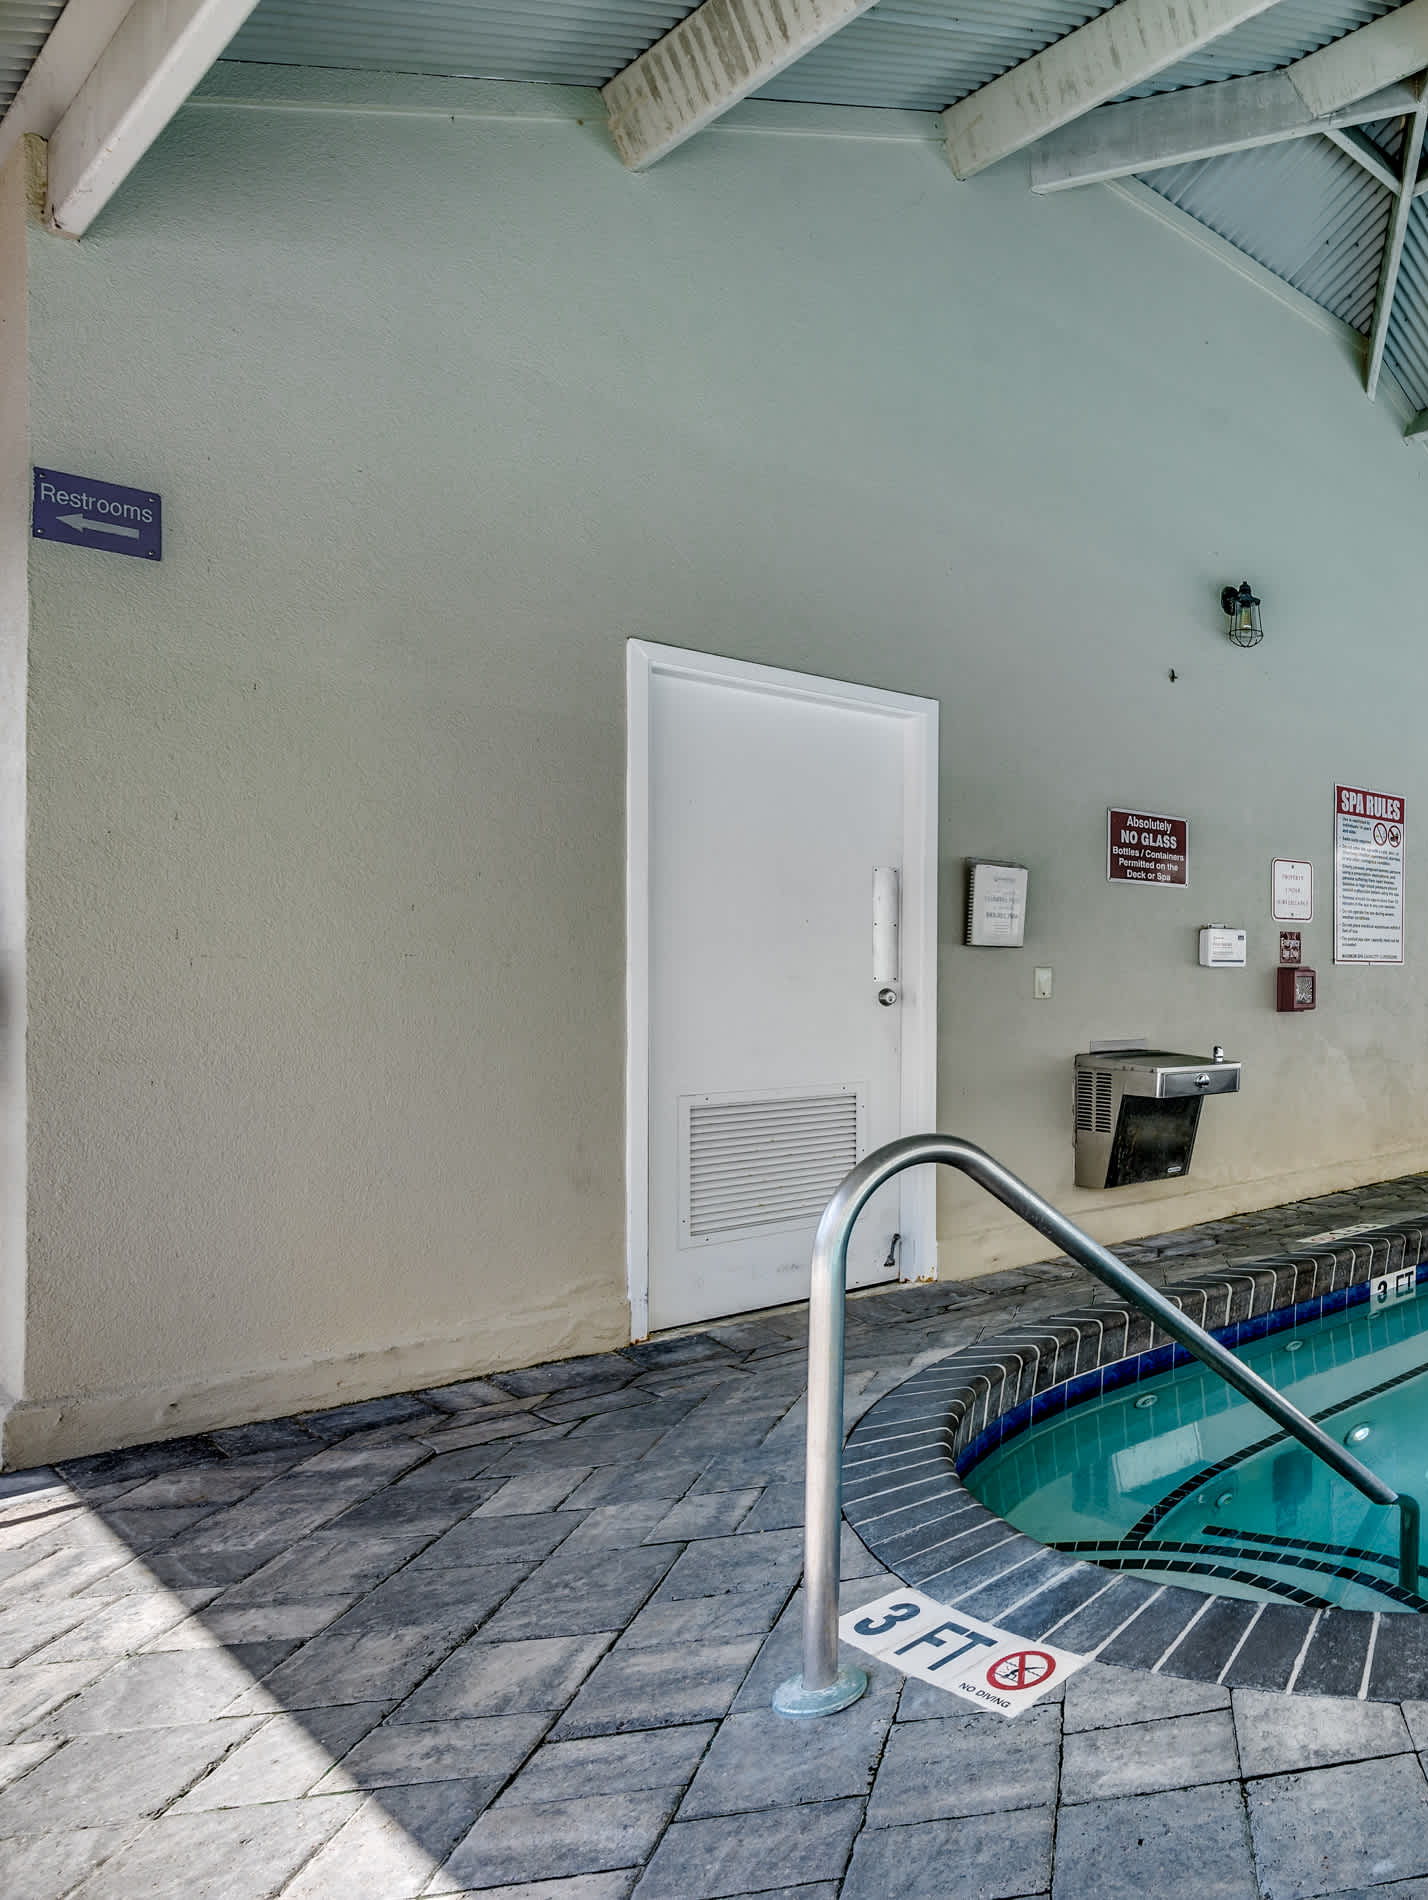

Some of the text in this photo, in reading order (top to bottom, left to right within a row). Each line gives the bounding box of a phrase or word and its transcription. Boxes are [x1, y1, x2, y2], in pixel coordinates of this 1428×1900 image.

[40, 482, 153, 523] Restrooms
[1341, 790, 1401, 820] SPA RULES
[1126, 815, 1172, 834] Absolutely
[1121, 830, 1177, 849] NO GLASS
[1112, 846, 1140, 857] Bottles
[1145, 850, 1185, 861] Containers
[1119, 857, 1155, 869] Permitted
[1167, 863, 1179, 871] the
[1127, 869, 1146, 879] Deck
[1157, 872, 1171, 881] Spa
[1377, 1280, 1388, 1304] 3
[853, 1602, 999, 1672] 3 FT
[958, 1681, 1012, 1709] NO DIVING
